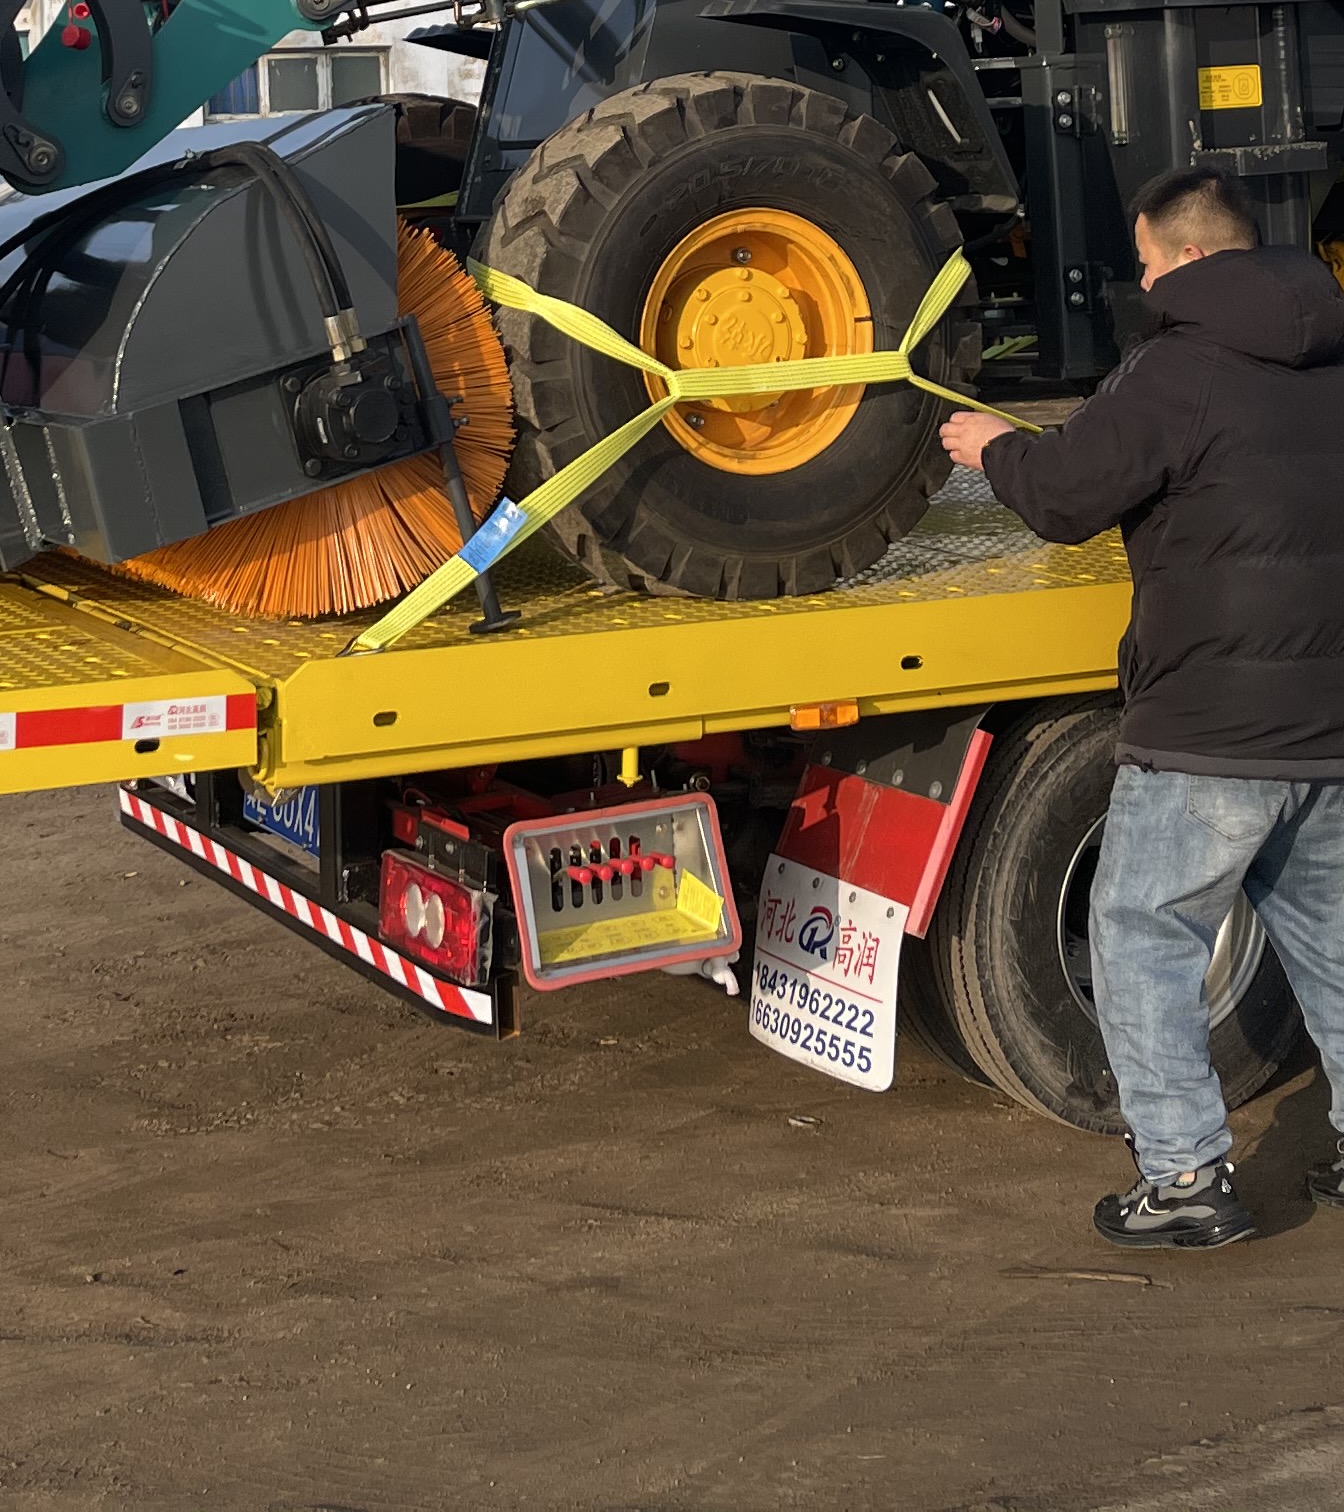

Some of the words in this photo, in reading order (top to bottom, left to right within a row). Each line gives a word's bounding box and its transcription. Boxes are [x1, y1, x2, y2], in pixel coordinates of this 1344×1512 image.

[761, 890, 796, 944] 河北
[832, 919, 881, 985] 高润
[752, 996, 872, 1074] 16630925555
[756, 961, 876, 1038] 18431962222
